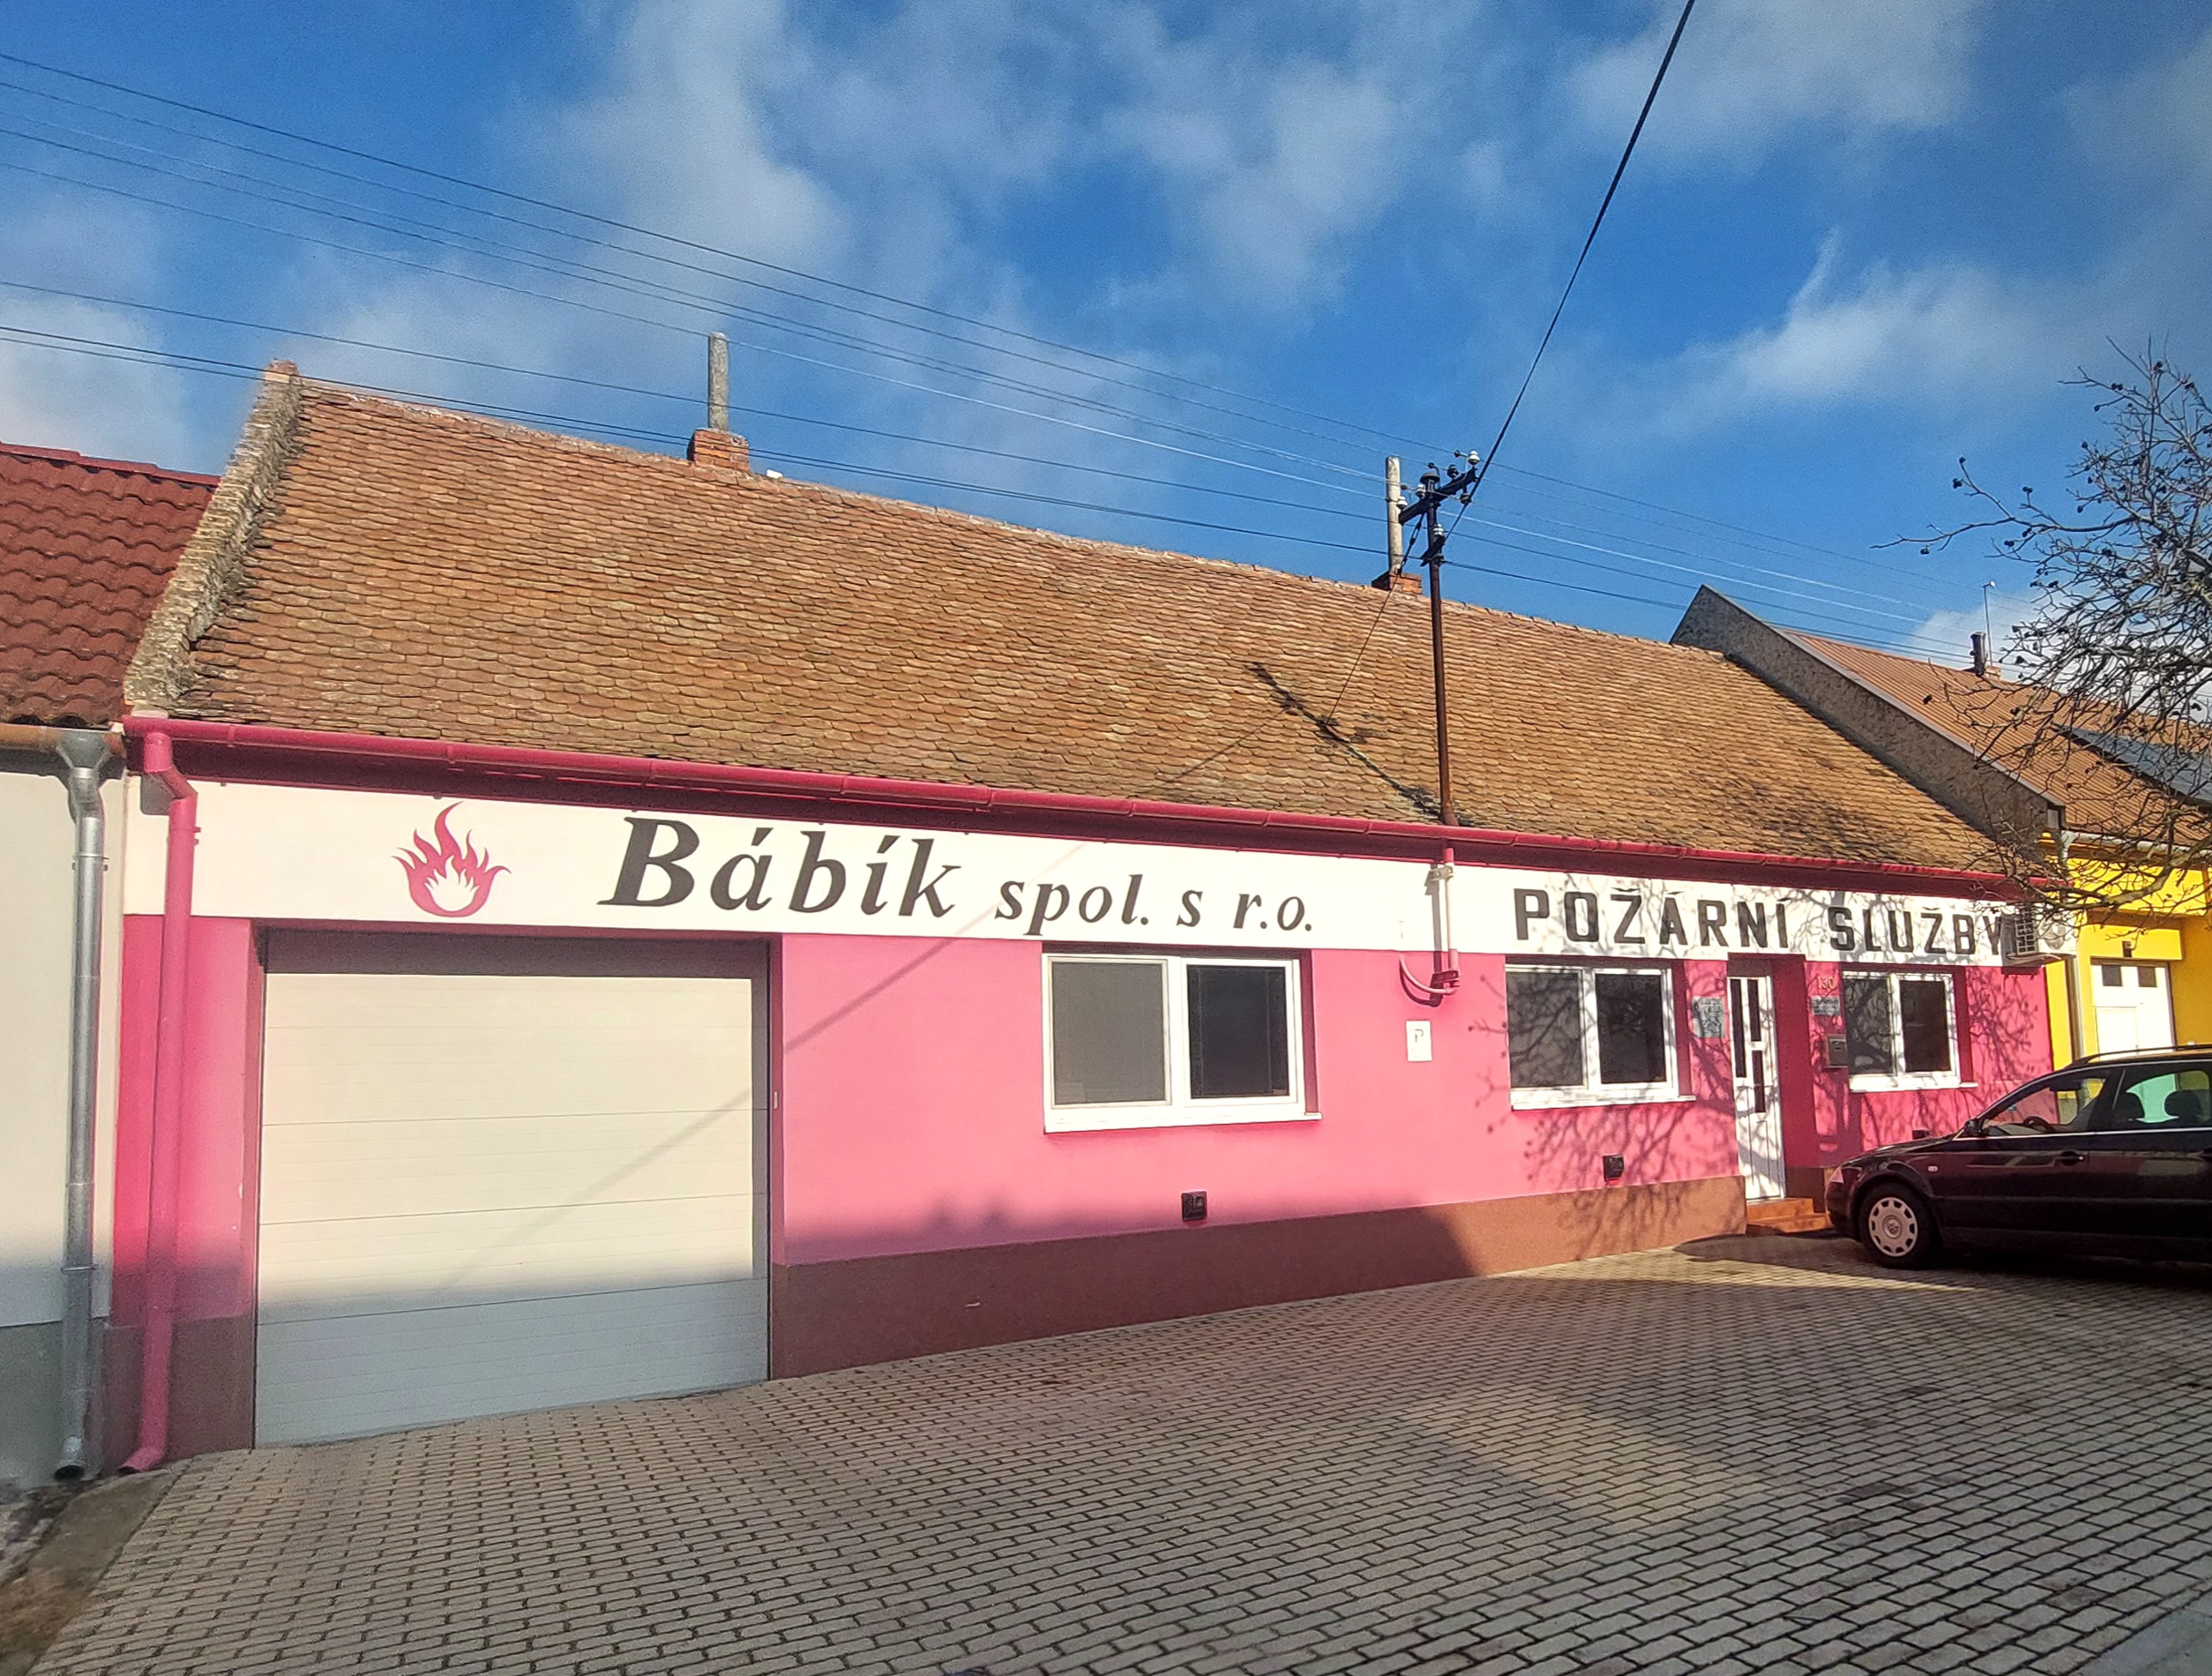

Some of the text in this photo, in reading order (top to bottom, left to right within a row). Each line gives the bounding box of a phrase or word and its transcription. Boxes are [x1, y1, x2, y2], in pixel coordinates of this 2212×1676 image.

[597, 816, 1314, 936] Bábík spol. s r.o.
[1513, 887, 2001, 955] POŽÁRNÍ SLUŽBY
